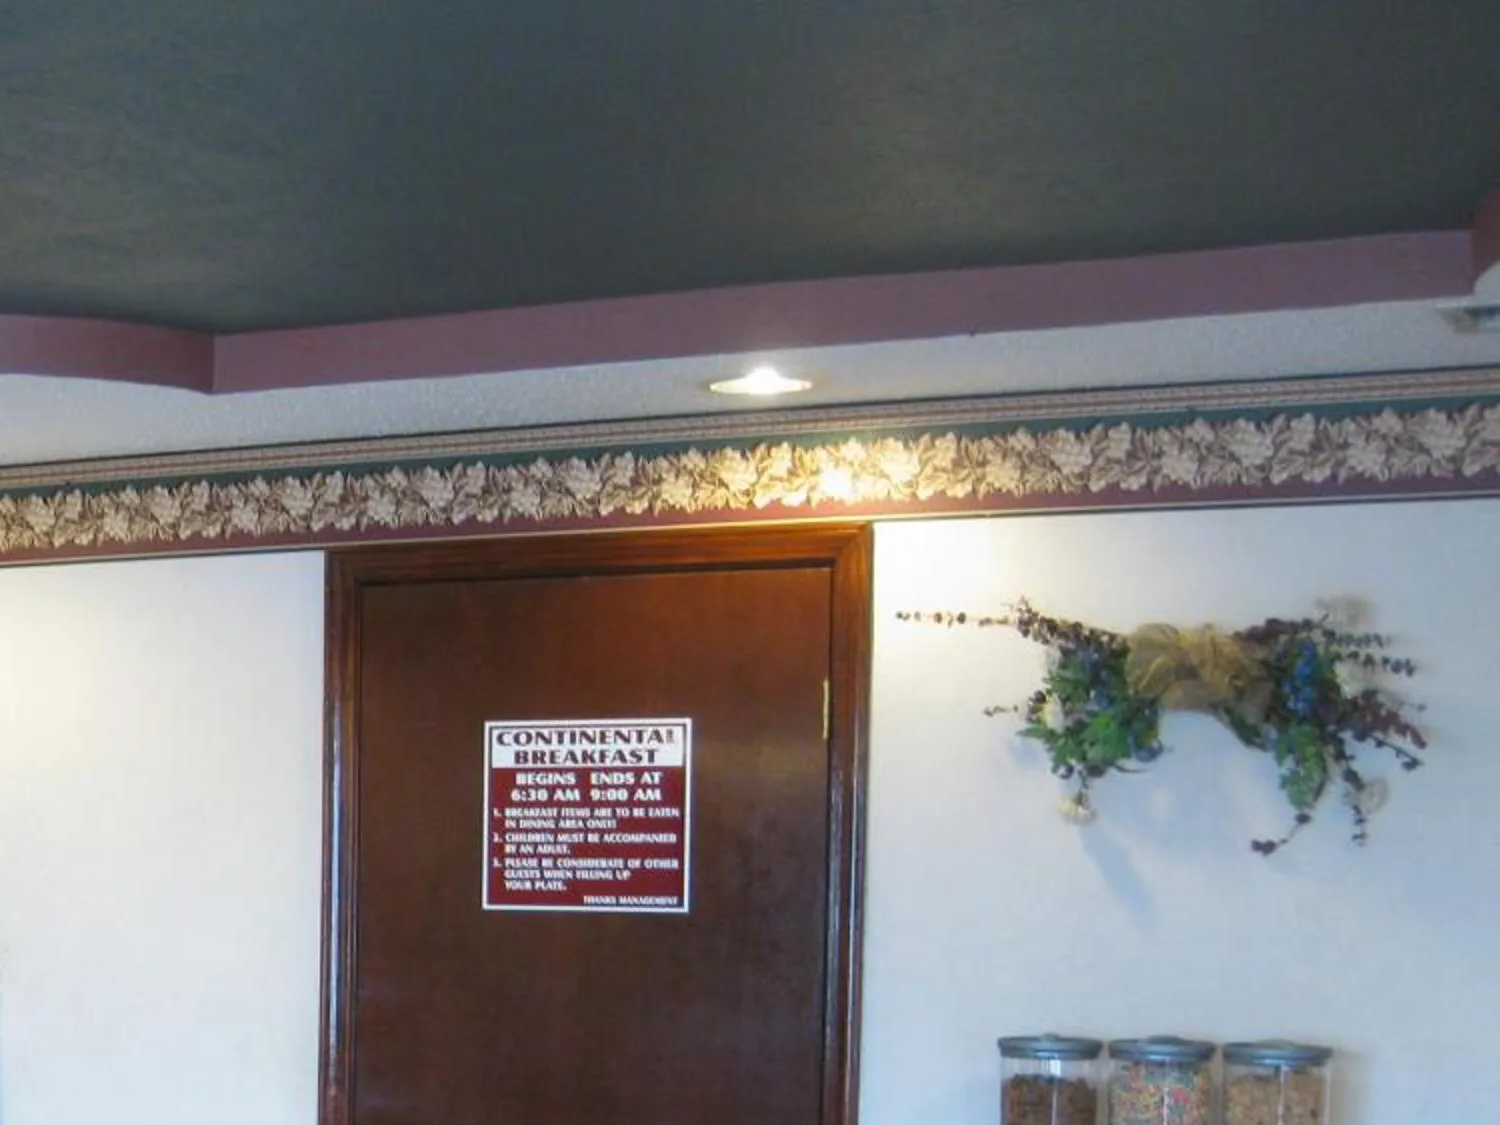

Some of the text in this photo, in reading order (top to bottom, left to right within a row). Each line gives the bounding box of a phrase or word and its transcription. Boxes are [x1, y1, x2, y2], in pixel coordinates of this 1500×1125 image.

[514, 749, 657, 765] BREAKFAST
[515, 771, 663, 785] BEGINS ENDS AT
[510, 788, 662, 801] 6:30 AM 9:00 AM
[505, 807, 558, 817] BREAKFAST
[615, 807, 630, 817] TO
[505, 819, 517, 829] IN
[519, 819, 556, 829] DINING
[558, 819, 585, 829] AREA
[556, 832, 585, 843] MUST
[519, 844, 535, 855] AN
[615, 869, 632, 880] UP
